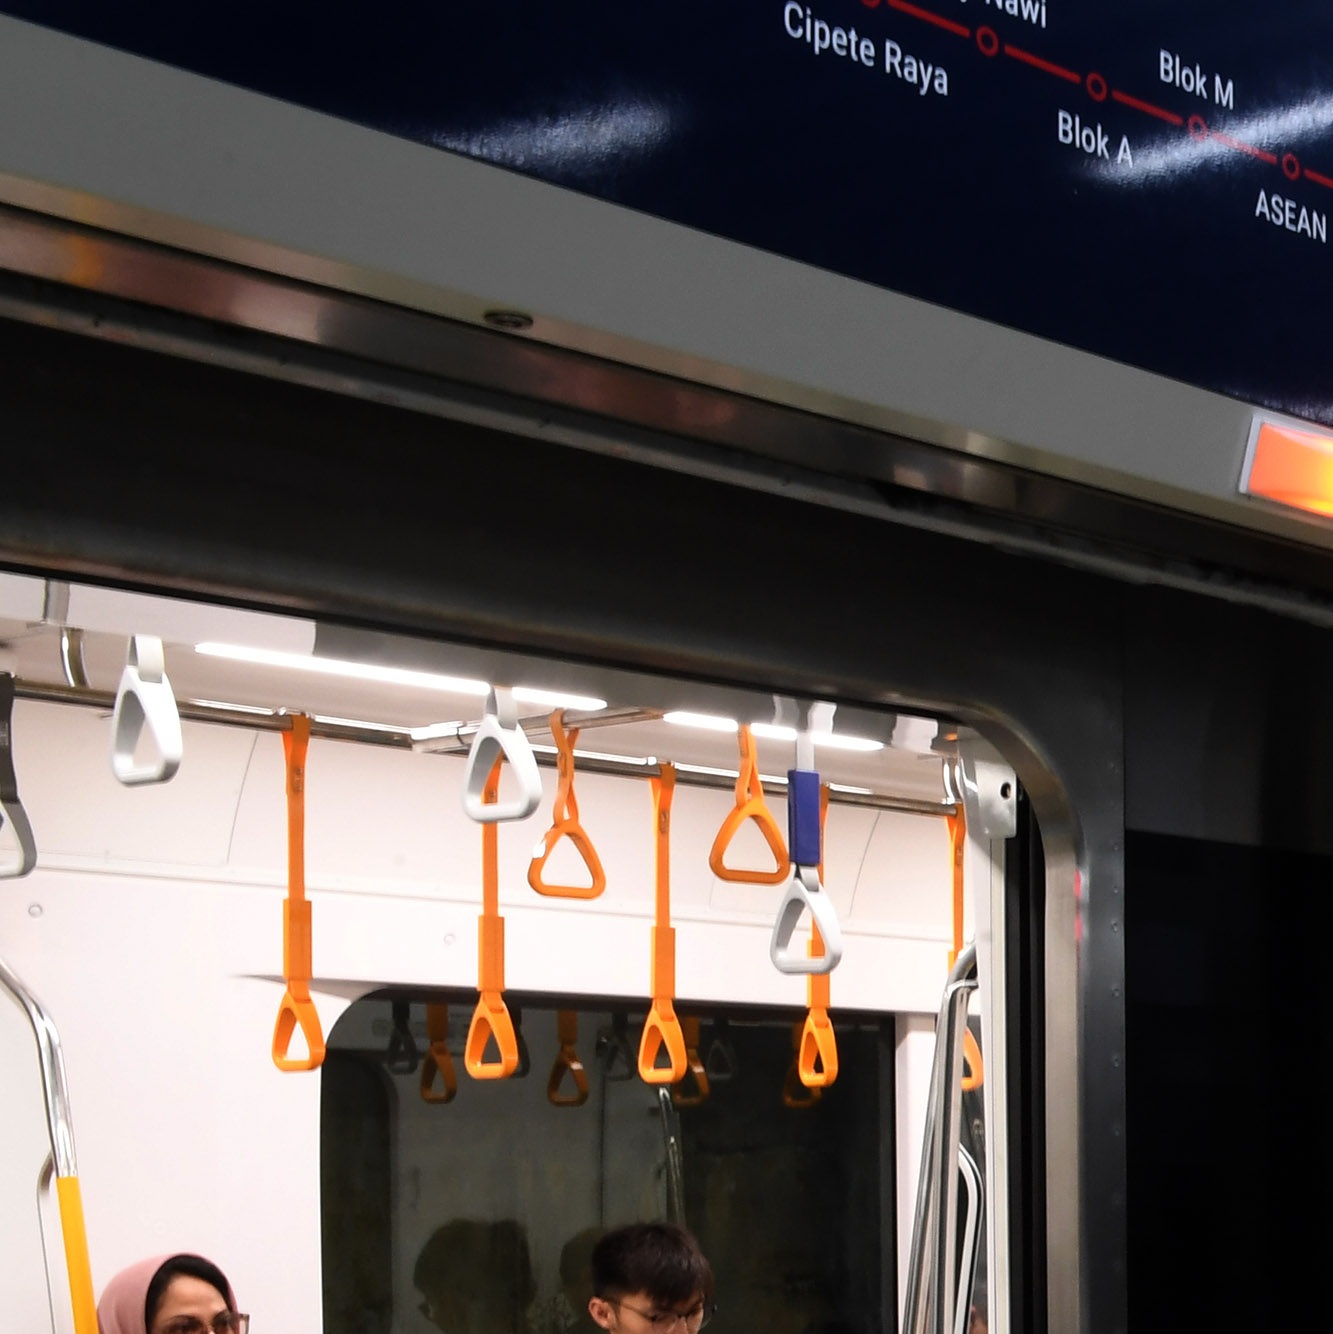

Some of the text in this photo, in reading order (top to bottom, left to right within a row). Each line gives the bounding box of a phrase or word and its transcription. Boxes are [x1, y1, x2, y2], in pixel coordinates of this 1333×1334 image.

[783, 0, 949, 96] Cipete Raya
[1159, 48, 1234, 110] Blok M
[1058, 108, 1134, 168] Blok A
[1255, 188, 1327, 243] ASEAN
